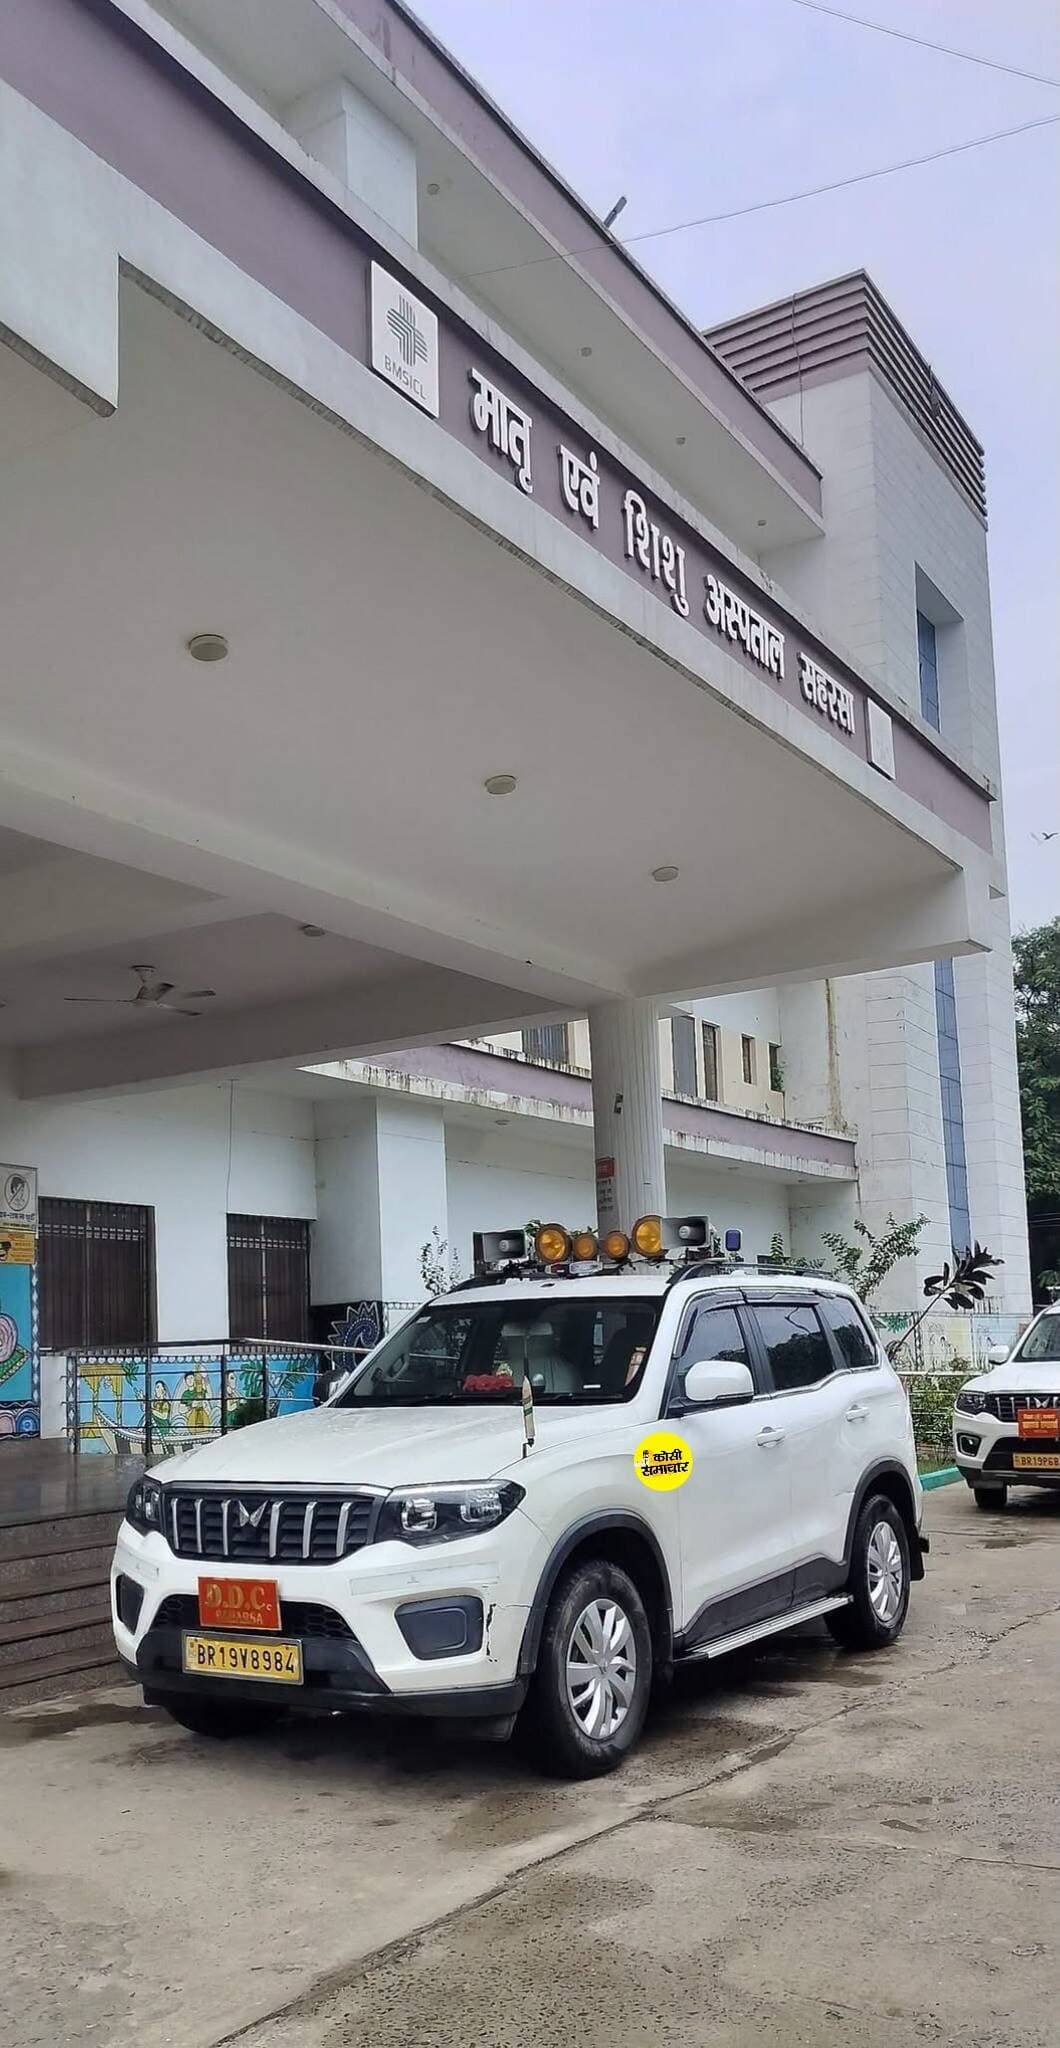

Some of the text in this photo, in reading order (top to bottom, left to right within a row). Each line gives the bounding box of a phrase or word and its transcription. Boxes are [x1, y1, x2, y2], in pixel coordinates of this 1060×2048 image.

[384, 355, 427, 400] BMSICL
[471, 367, 856, 734] मातृ एवं शिशु अस्पताल सहरसा
[197, 1644, 295, 1673] BR19V8984
